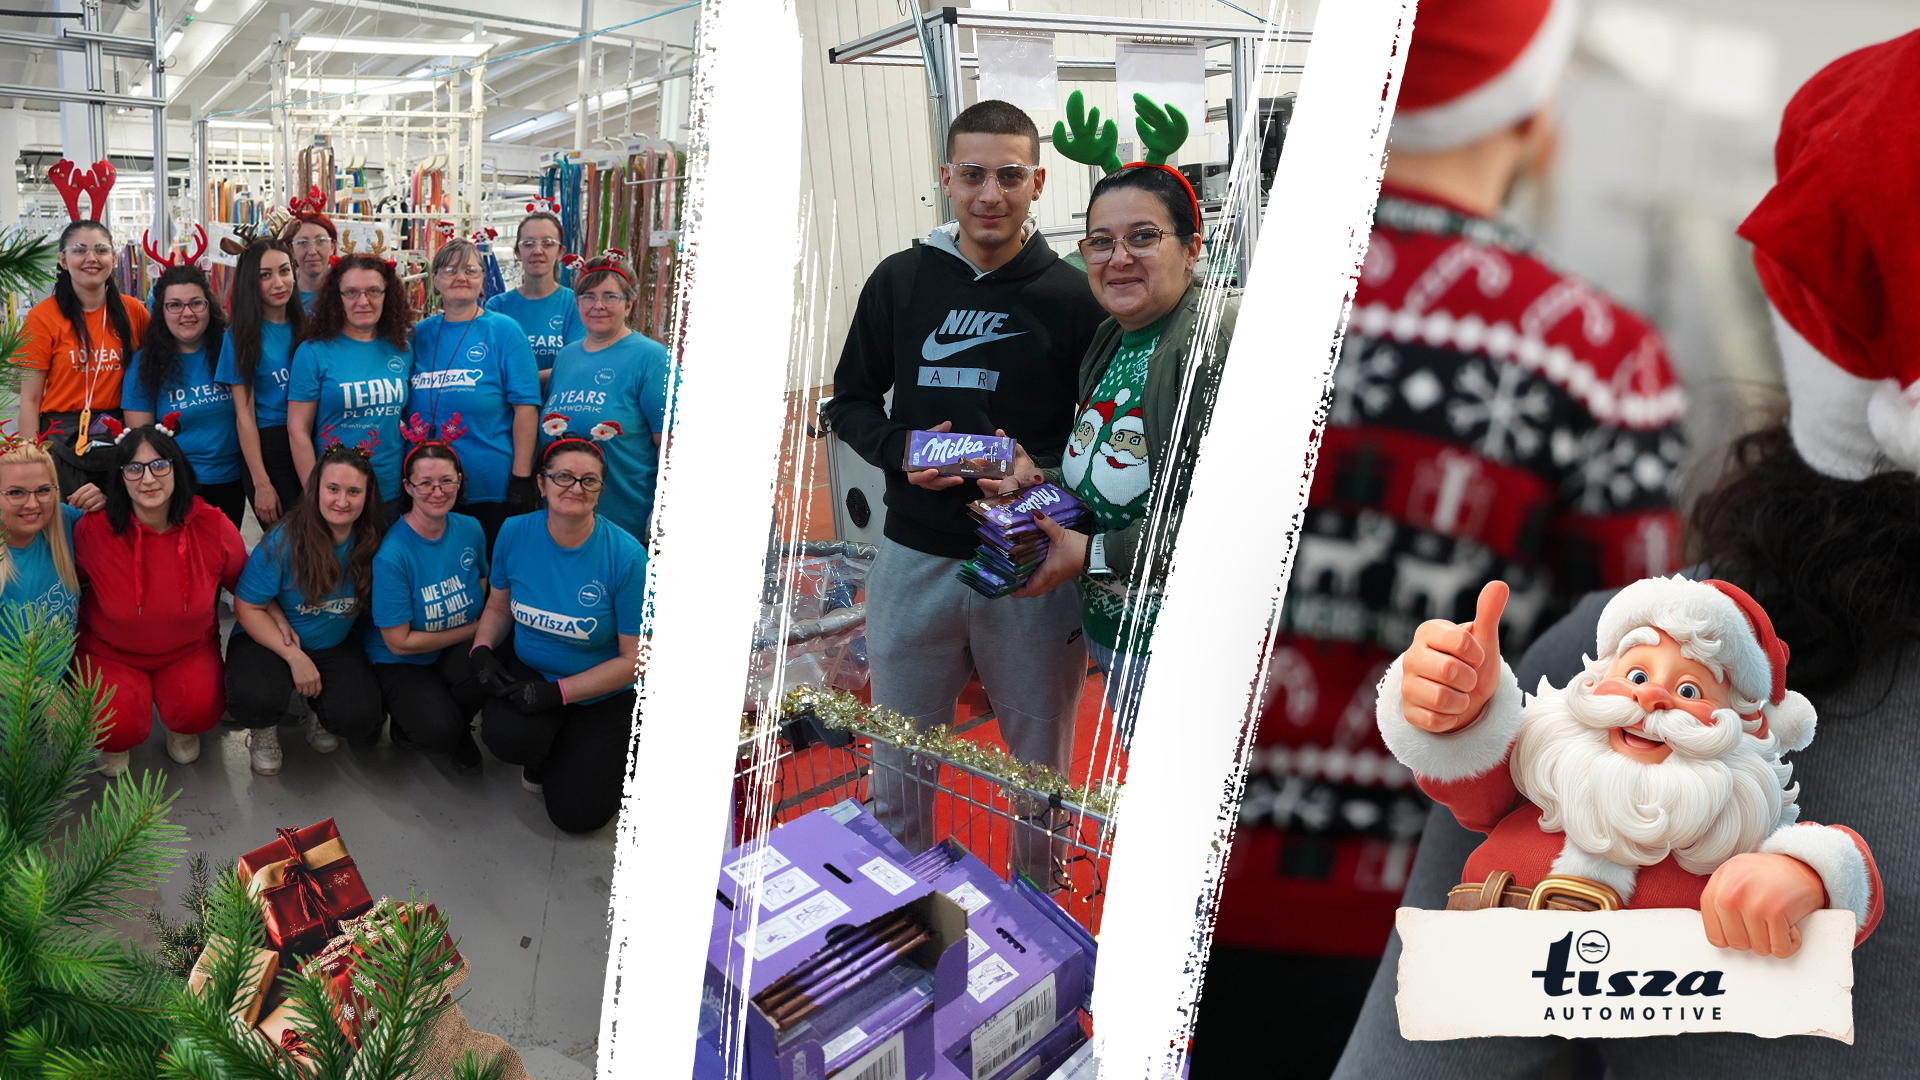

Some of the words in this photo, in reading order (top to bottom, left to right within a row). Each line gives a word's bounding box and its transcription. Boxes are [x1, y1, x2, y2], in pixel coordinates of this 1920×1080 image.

[938, 309, 1010, 336] NIKE
[527, 335, 564, 347] EARS
[69, 349, 88, 364] 10
[930, 369, 987, 387] AIR
[168, 388, 186, 403] 10
[339, 377, 404, 409] TEAM
[560, 389, 607, 405] YEARS
[343, 405, 402, 419] PLAYER
[921, 435, 986, 464] Milka
[421, 583, 442, 603] WE
[440, 574, 466, 597] CAN,
[424, 602, 445, 620] WE
[445, 591, 474, 614] WILL,
